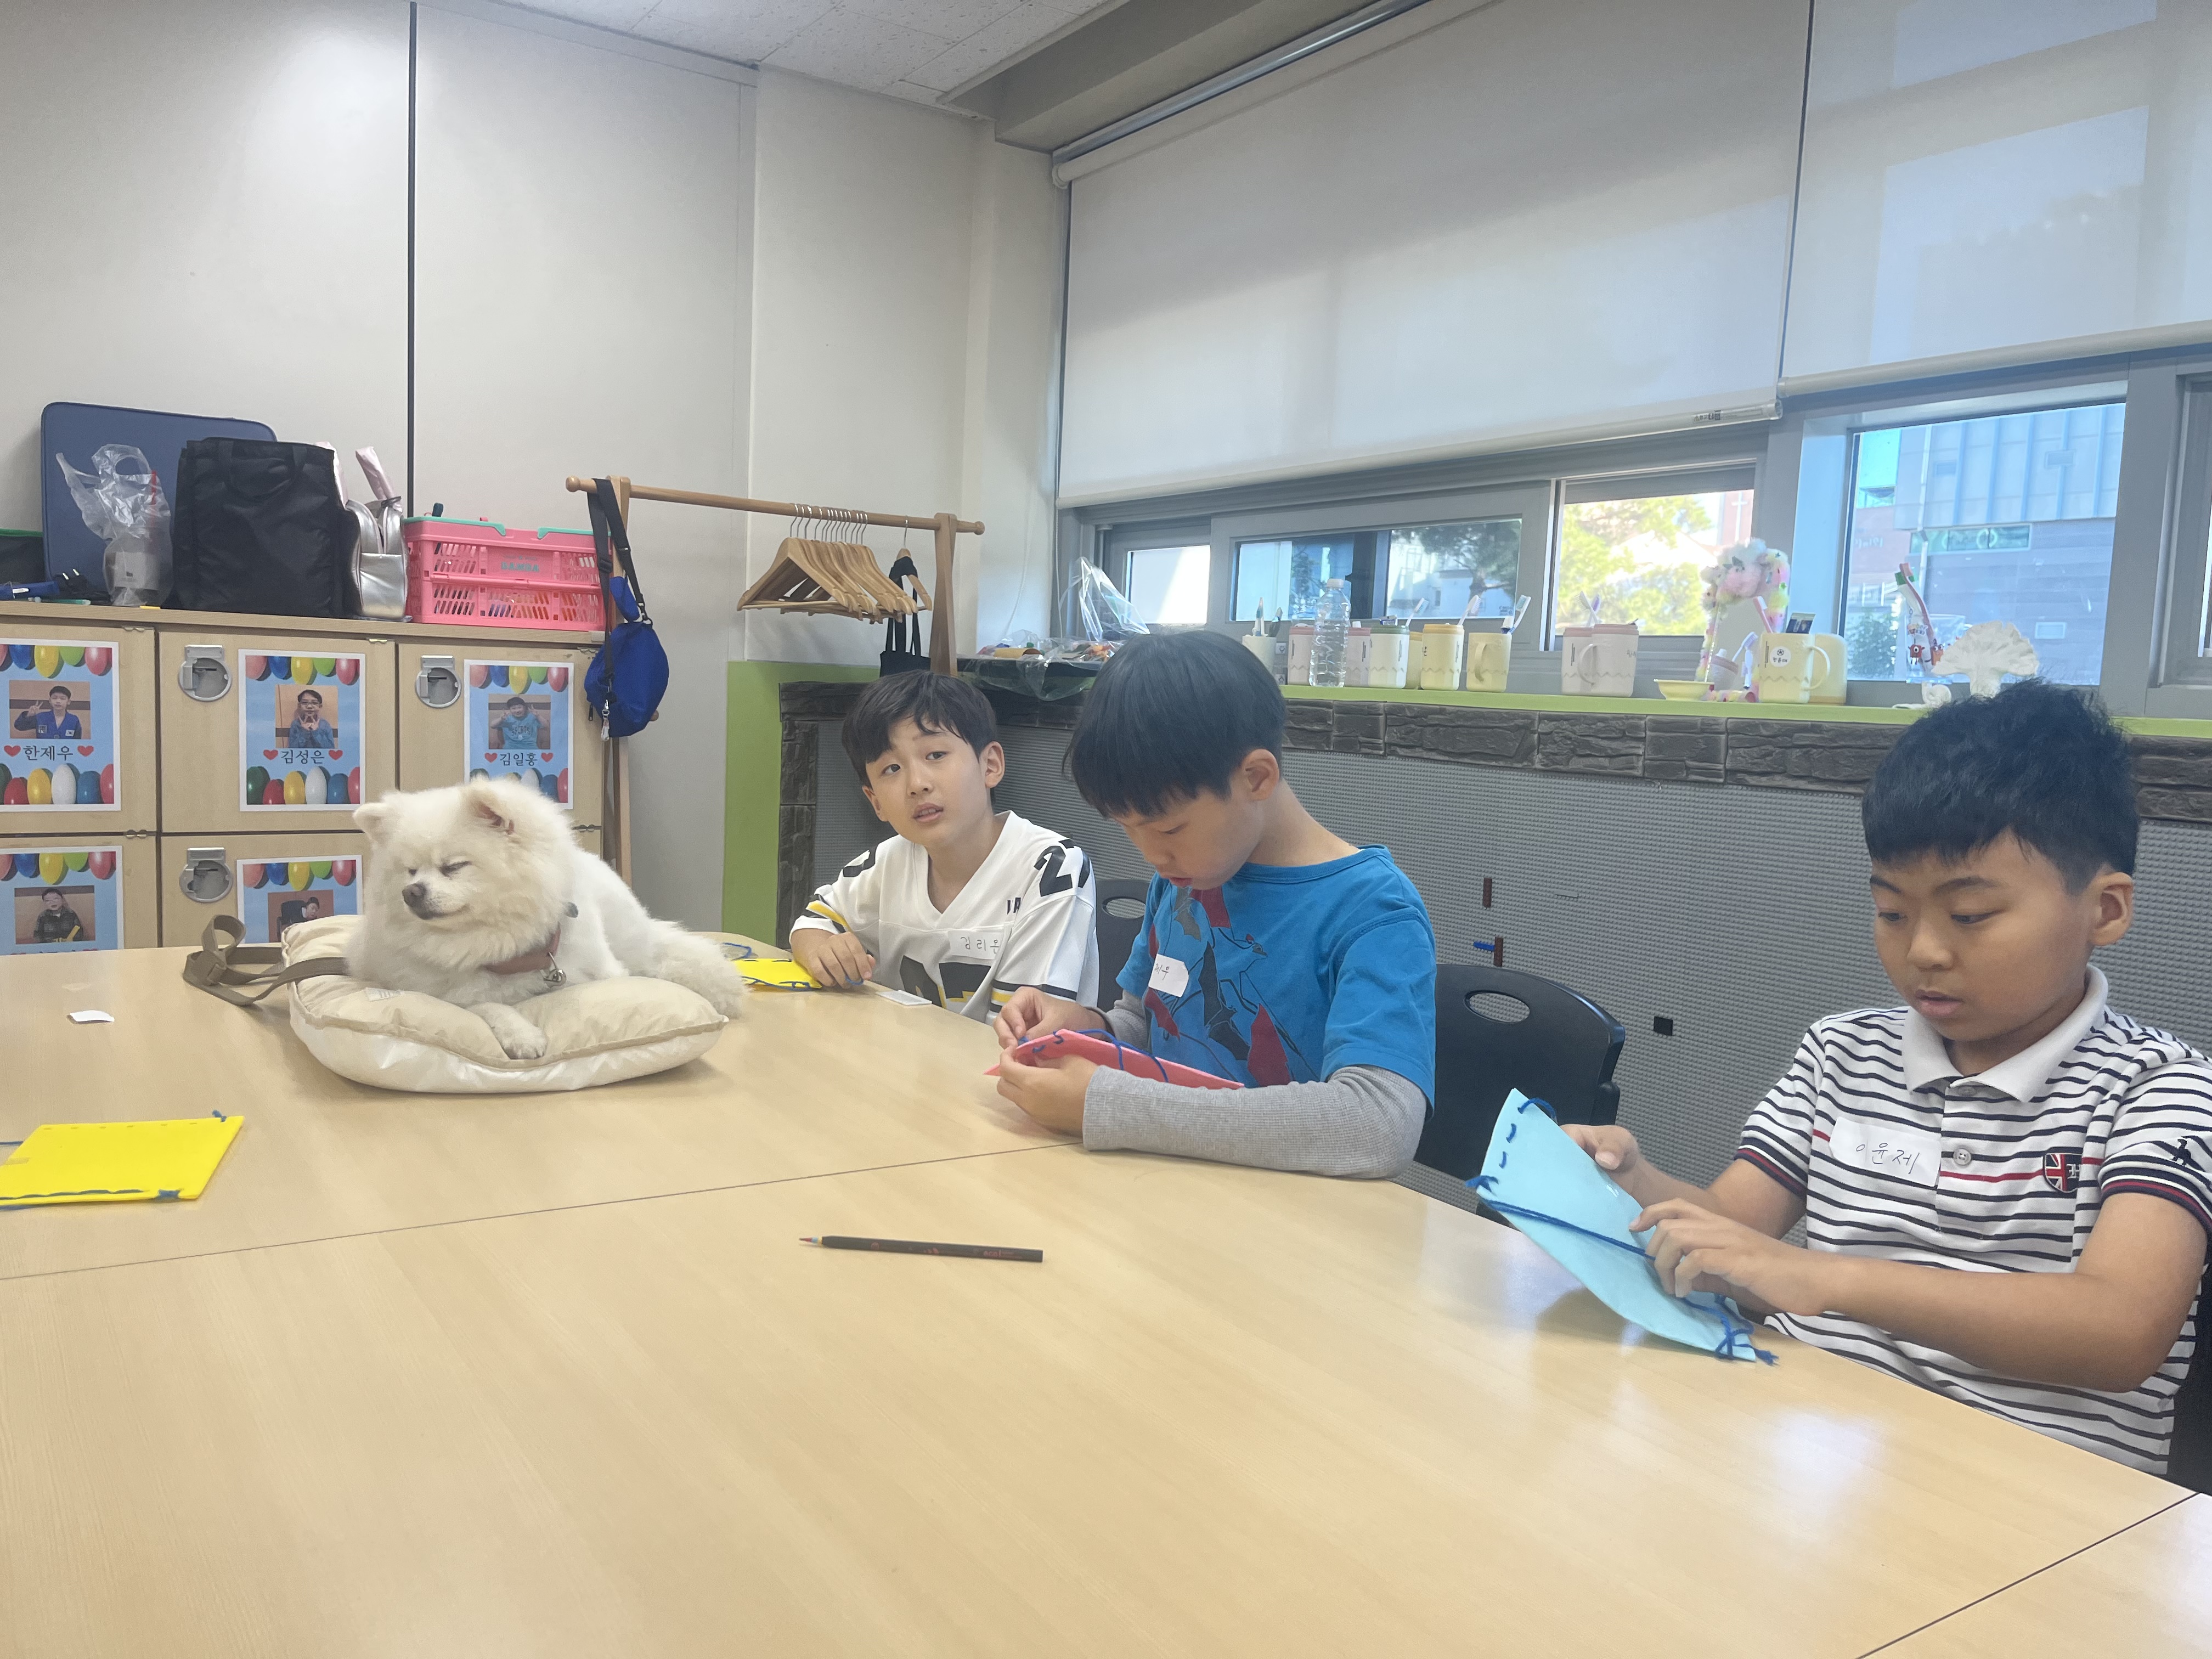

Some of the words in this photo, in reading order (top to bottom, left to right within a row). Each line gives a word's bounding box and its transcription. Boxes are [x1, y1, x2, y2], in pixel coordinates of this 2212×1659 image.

[23, 745, 74, 761] 한제우
[280, 749, 325, 764] 김성은
[499, 752, 538, 766] 김일홍
[1855, 1141, 1920, 1175] 이윤제
